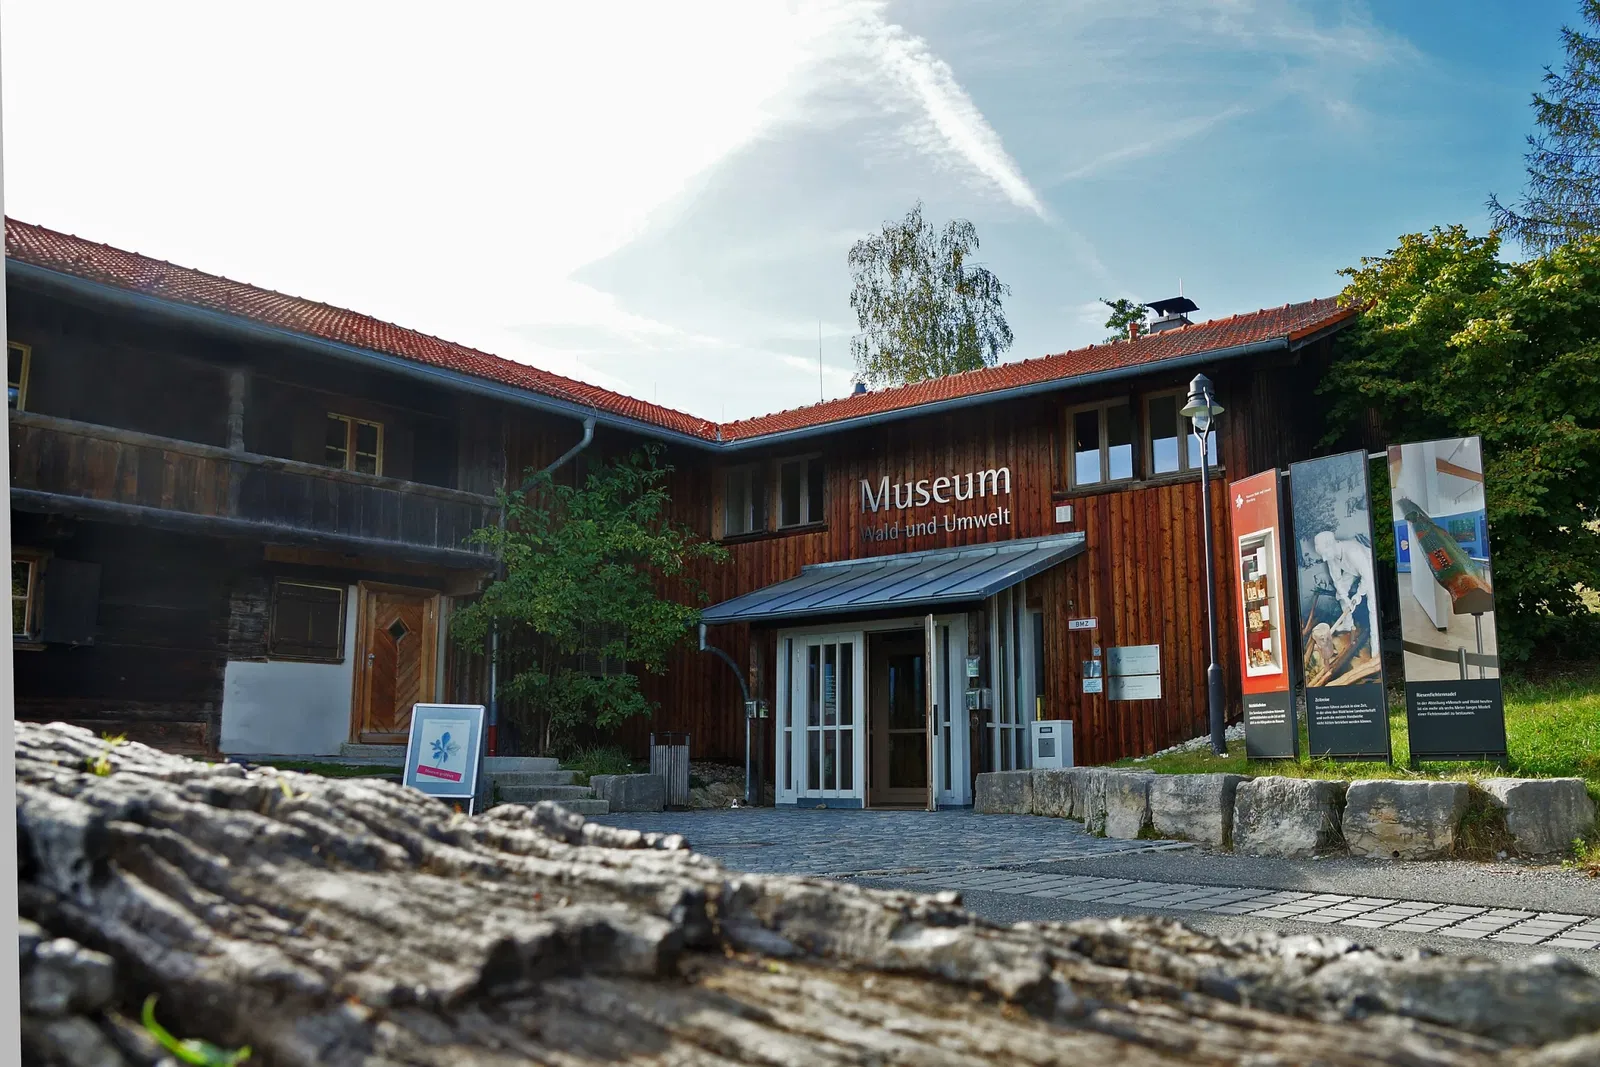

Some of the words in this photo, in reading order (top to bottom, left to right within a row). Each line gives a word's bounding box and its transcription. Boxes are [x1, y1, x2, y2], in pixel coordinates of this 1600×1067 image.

[859, 467, 1010, 513] Museum
[861, 522, 898, 542] Wald
[906, 516, 937, 537] und
[943, 507, 1011, 532] Umwelt
